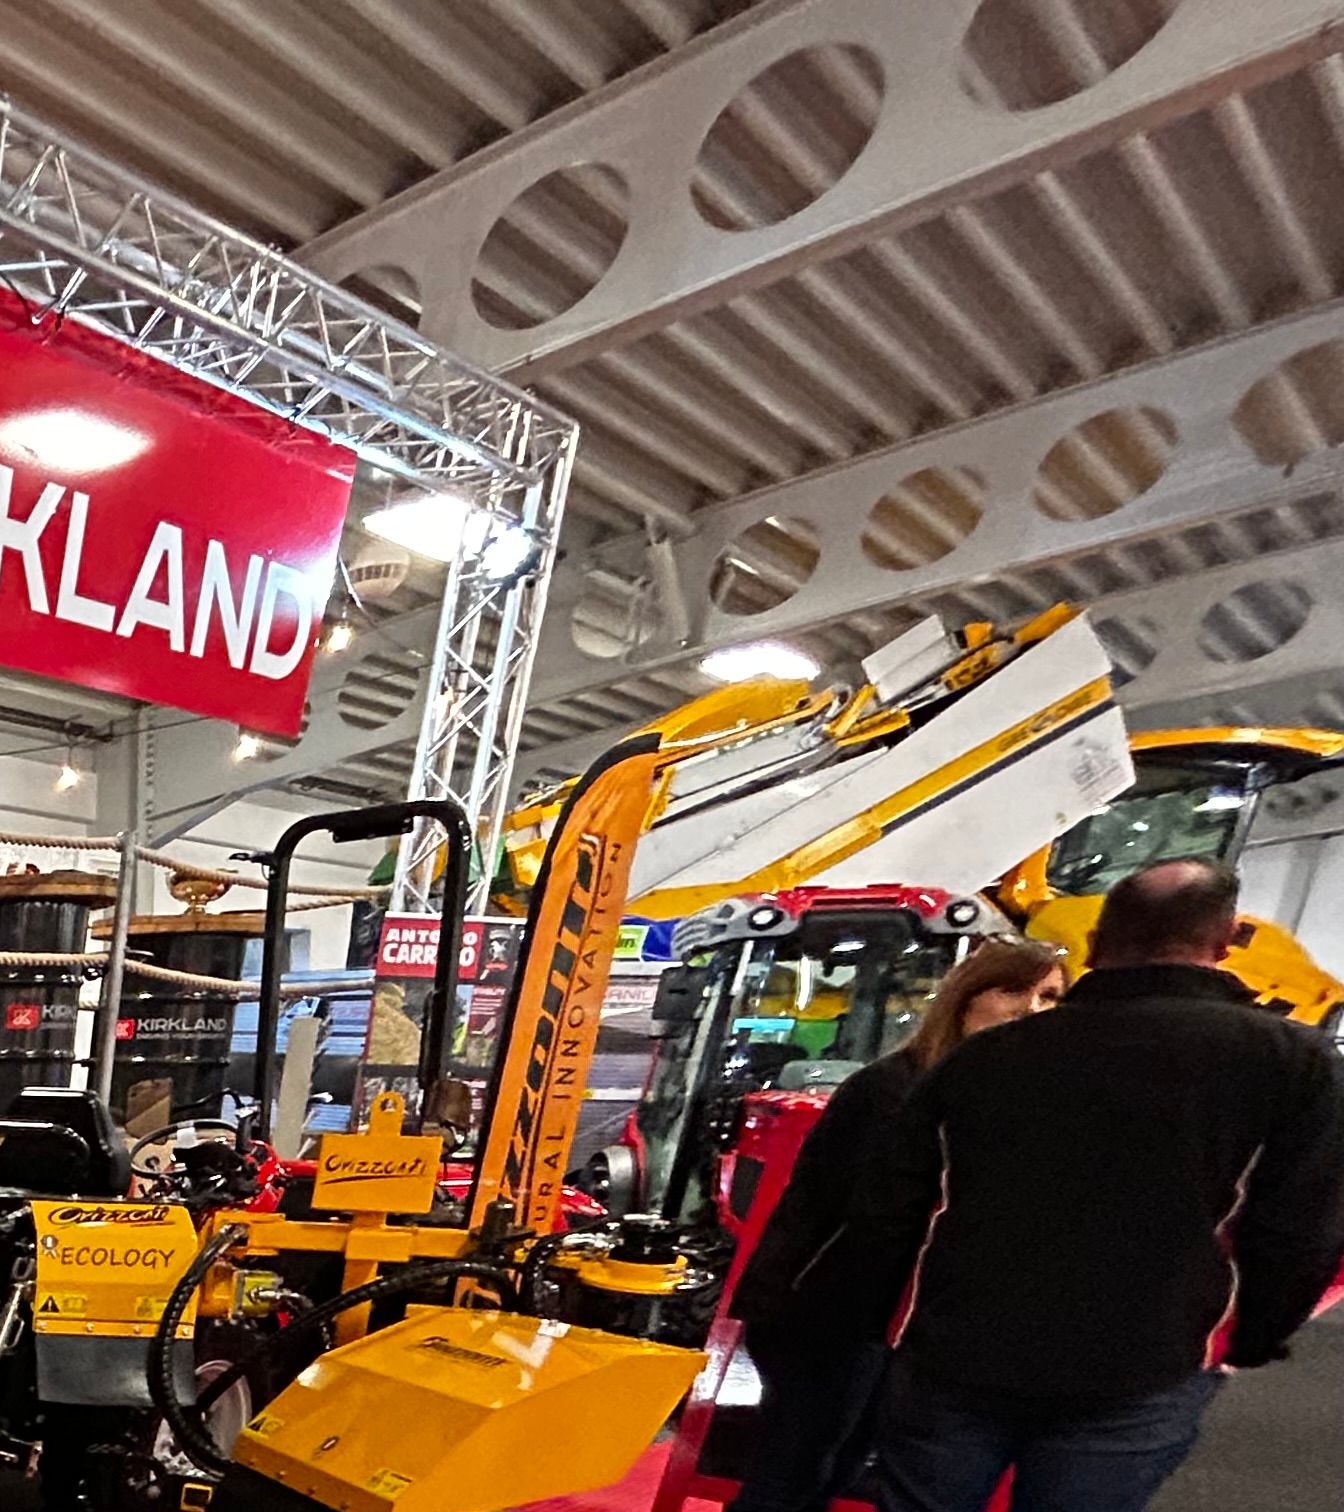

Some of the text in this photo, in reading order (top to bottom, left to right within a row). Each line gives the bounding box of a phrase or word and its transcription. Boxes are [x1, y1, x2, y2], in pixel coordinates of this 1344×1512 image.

[385, 928, 478, 946] ANTOO
[382, 943, 476, 967] CARRO
[554, 842, 622, 1102] INNOVATION
[136, 1017, 228, 1032] KIRKLAND
[60, 1246, 176, 1269] ECOLOGY
